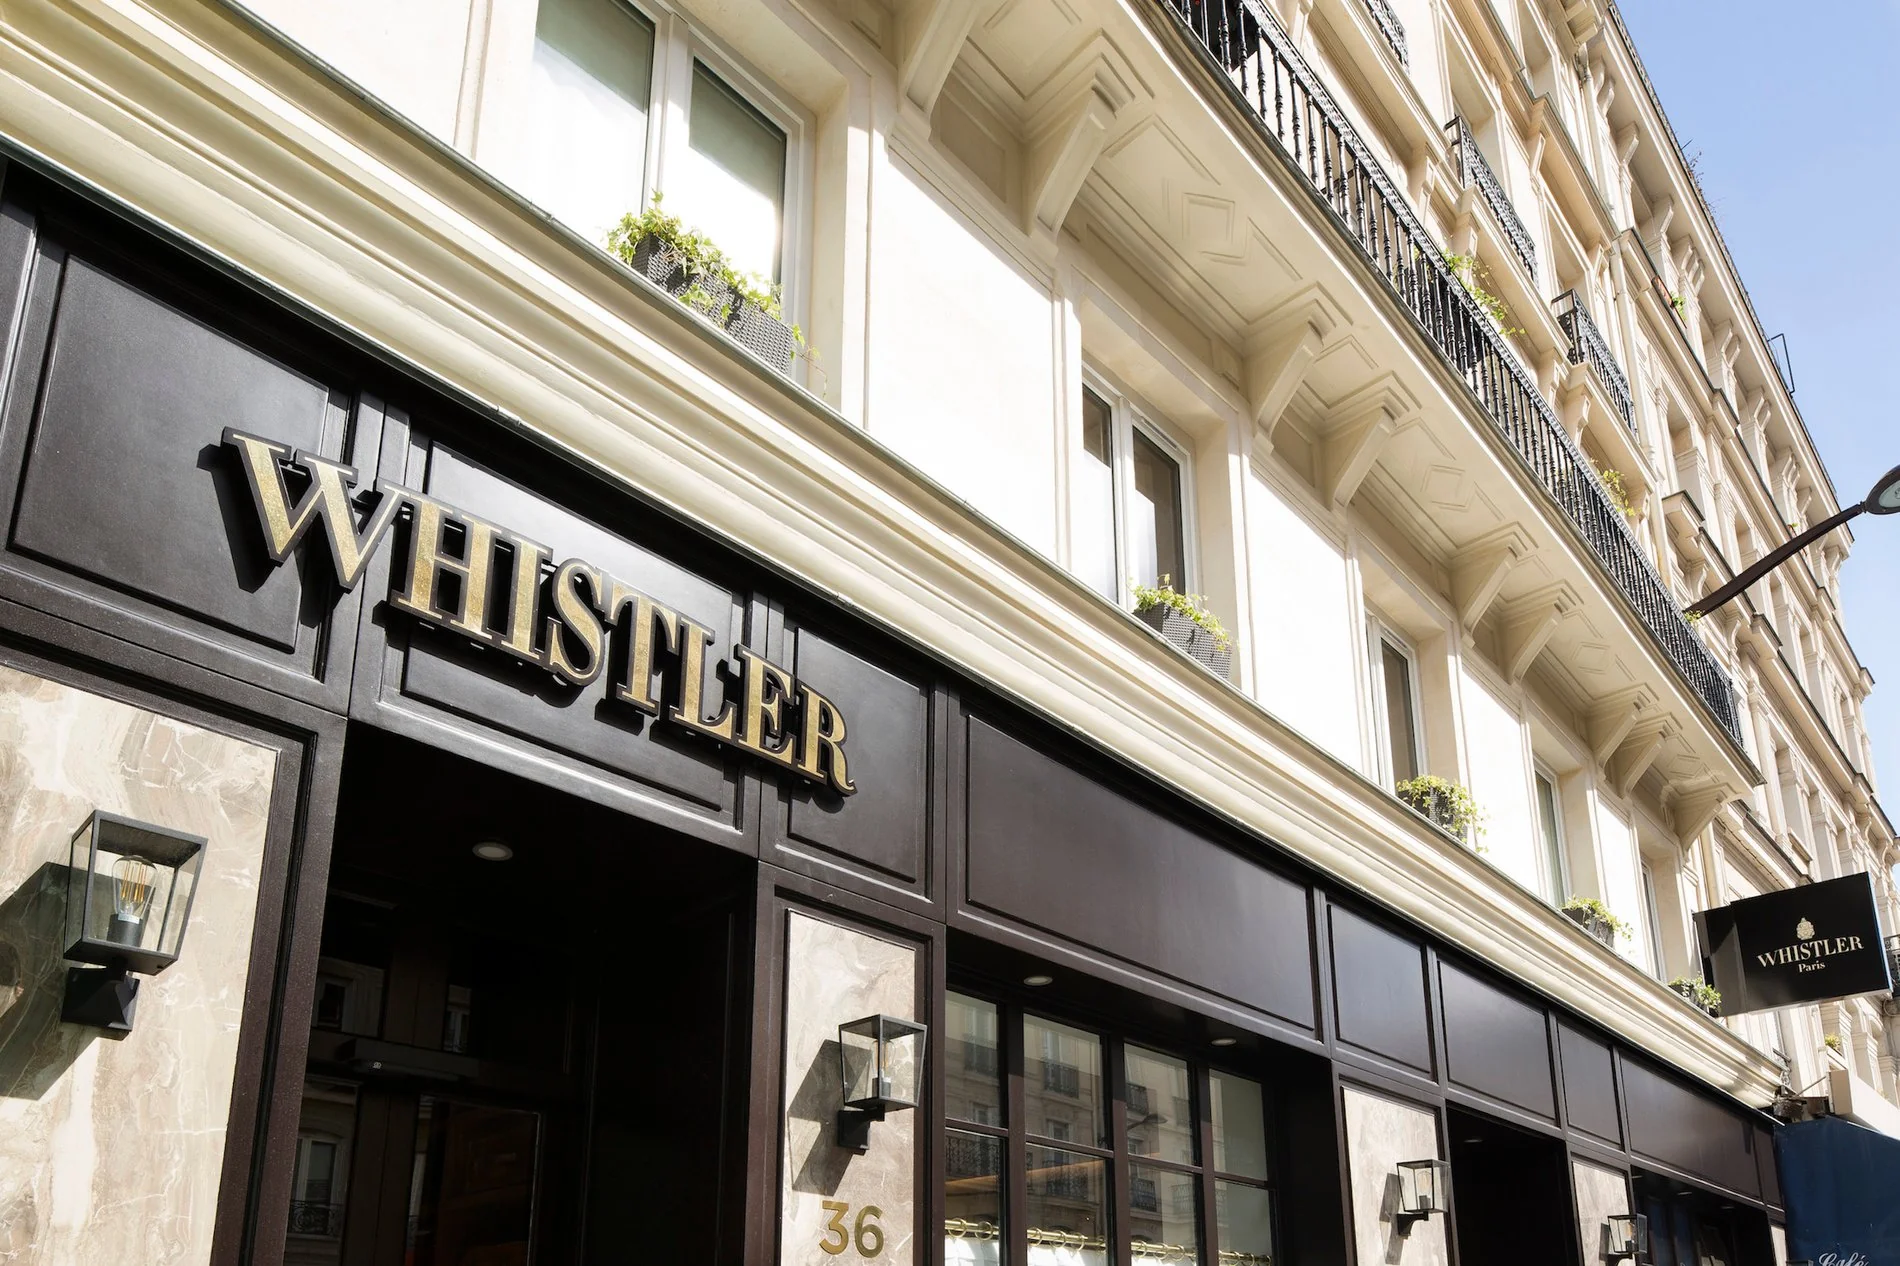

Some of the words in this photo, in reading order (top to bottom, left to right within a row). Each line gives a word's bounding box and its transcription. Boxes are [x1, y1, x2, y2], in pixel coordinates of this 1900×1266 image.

[223, 427, 857, 796] WHISTLER
[1757, 936, 1864, 967] WHISTLER
[1798, 960, 1826, 973] Paris
[819, 1200, 884, 1258] 36
